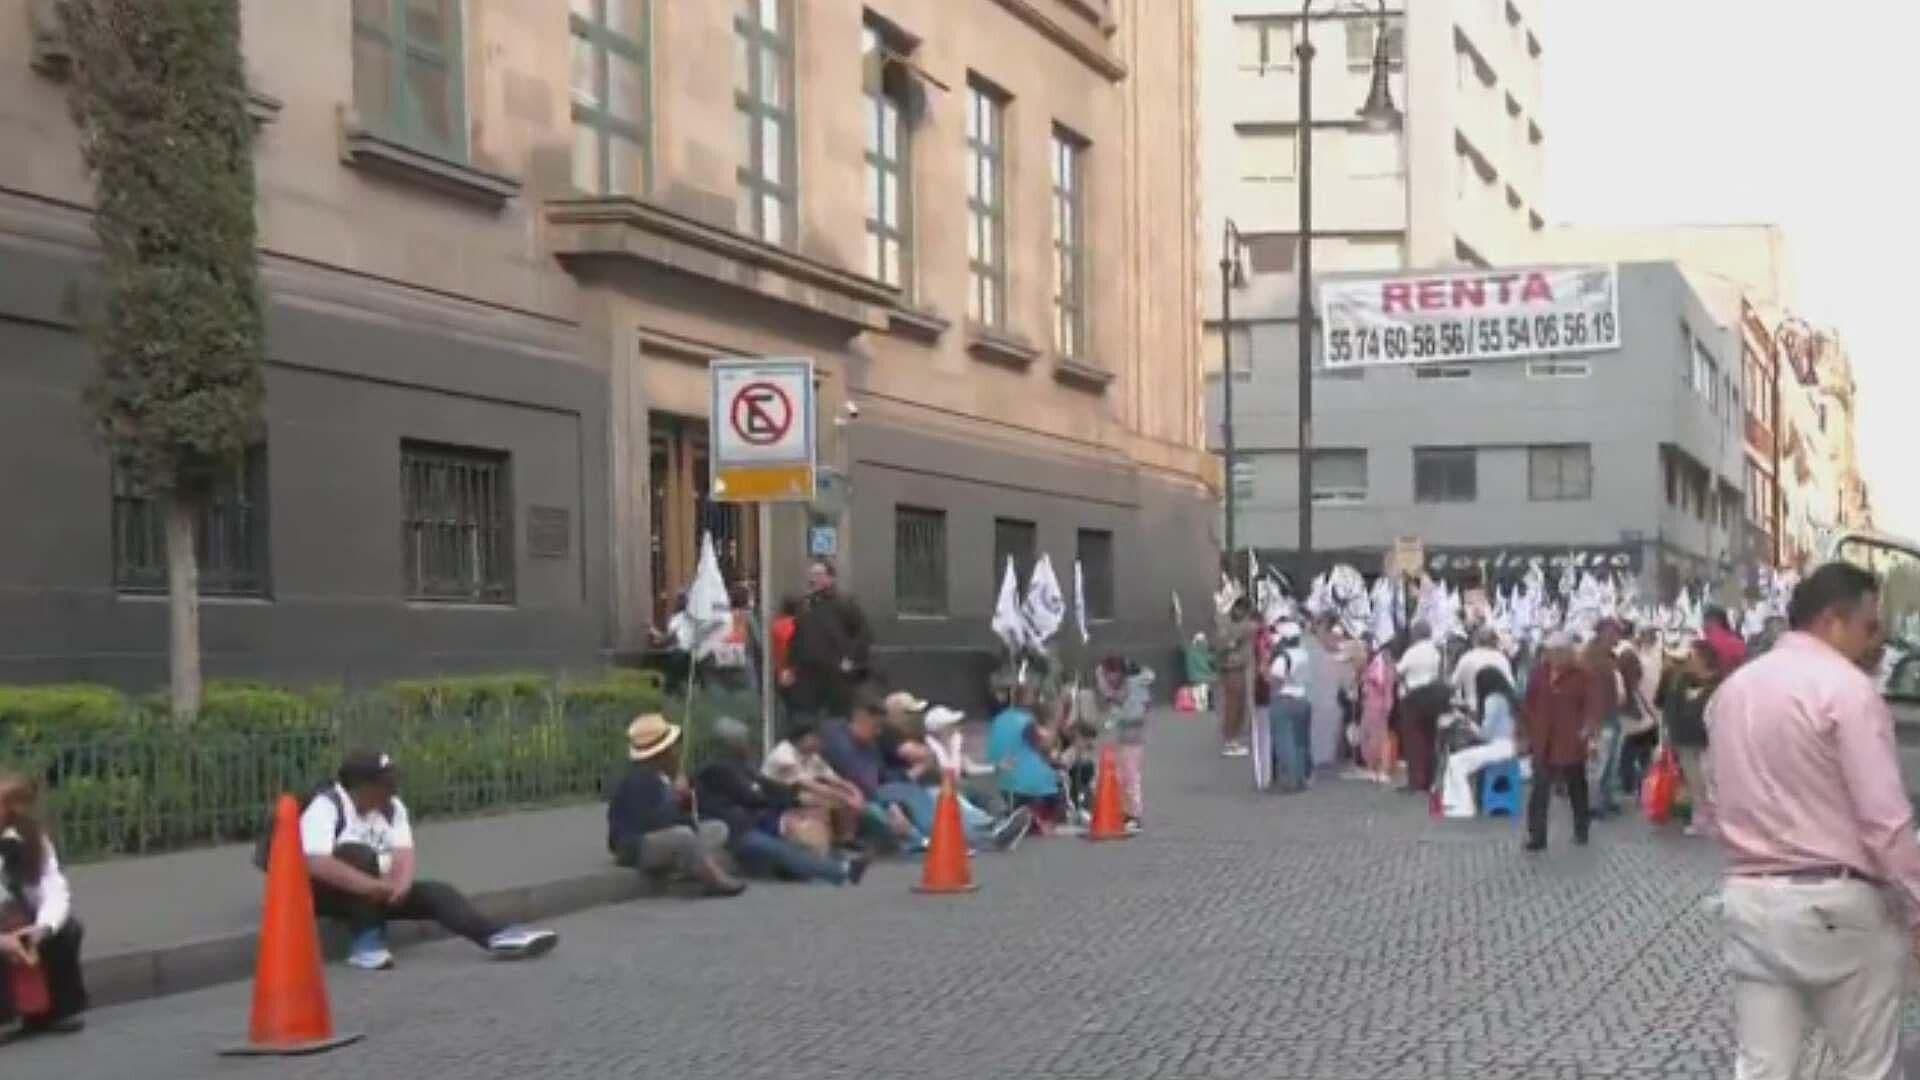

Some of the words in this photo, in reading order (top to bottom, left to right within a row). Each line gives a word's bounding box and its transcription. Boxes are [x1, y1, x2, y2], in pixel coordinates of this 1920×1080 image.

[1382, 273, 1553, 313] RENTA
[1356, 327, 1379, 360] 74
[1385, 326, 1407, 359] 60
[1507, 317, 1530, 350] 54
[1593, 311, 1615, 343] 19
